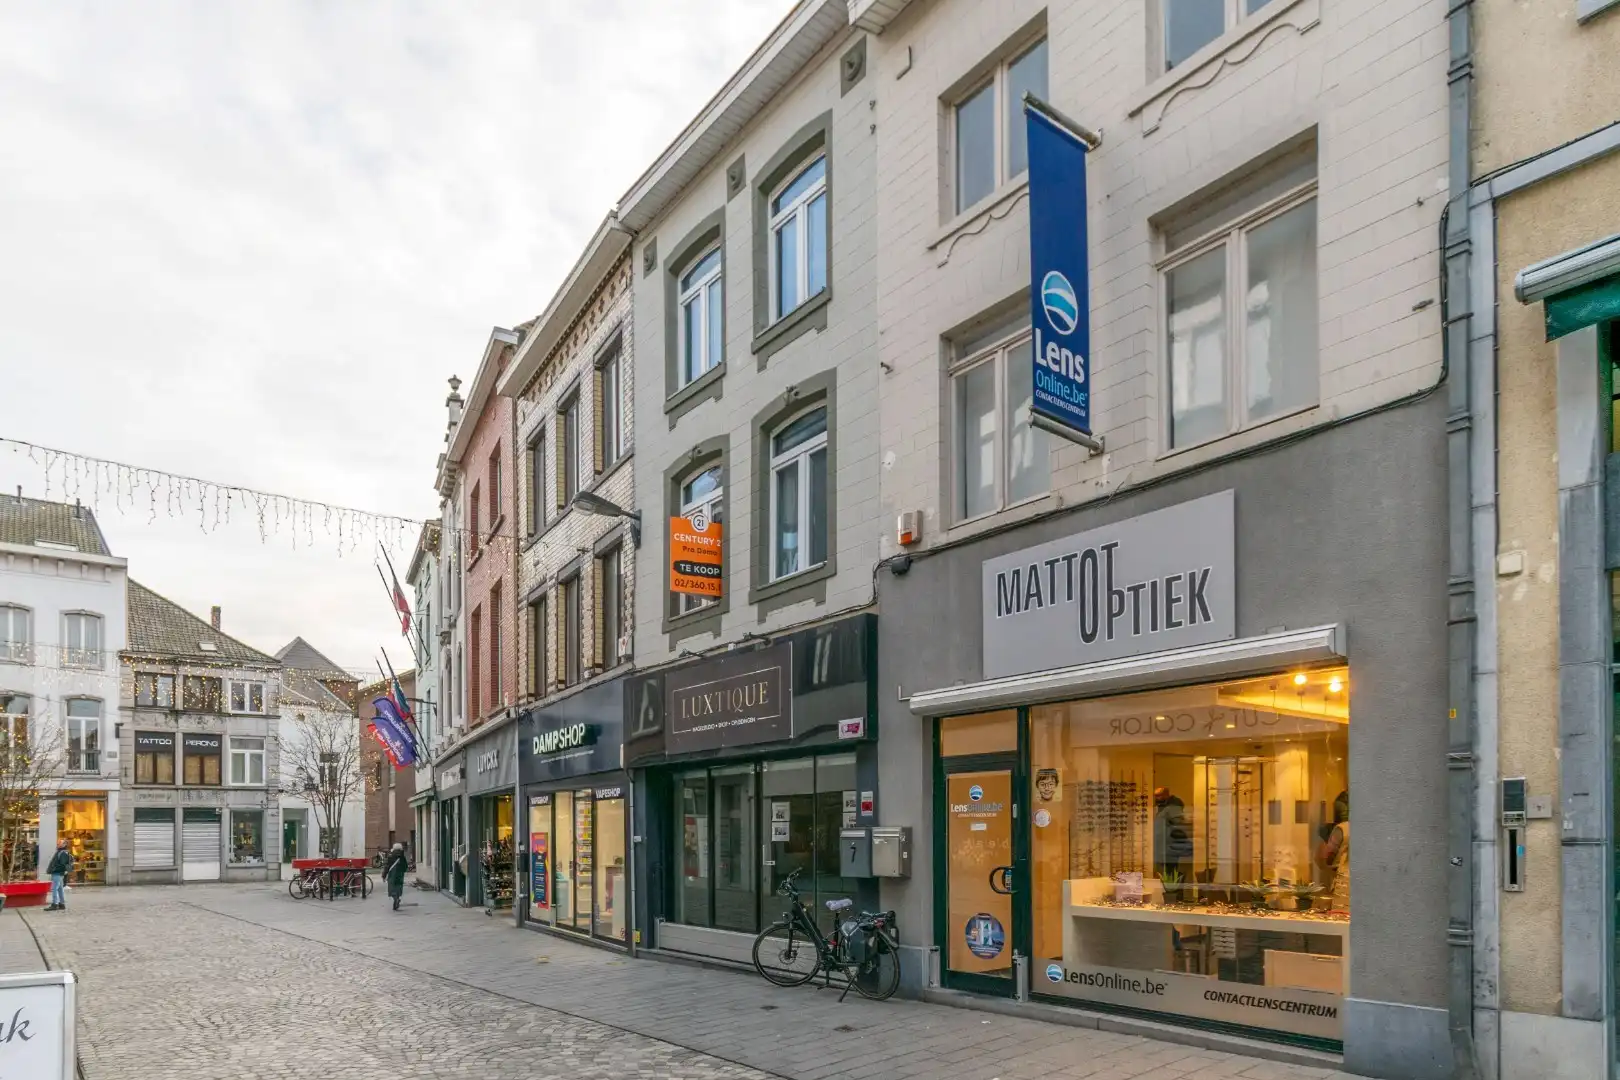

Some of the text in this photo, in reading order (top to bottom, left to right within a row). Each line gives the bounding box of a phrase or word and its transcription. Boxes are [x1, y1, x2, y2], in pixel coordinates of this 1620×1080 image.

[1035, 327, 1085, 384] Lens
[1036, 369, 1086, 407] Online.be
[1035, 389, 1086, 417] CONTACTLENSCENTRUM
[696, 519, 704, 527] 21
[673, 532, 721, 547] CENTURY 2
[680, 563, 720, 575] TE KOOP
[674, 578, 721, 592] 02/360.15.
[682, 681, 769, 719] LUXTIQUE
[138, 737, 172, 745] TATTOO
[533, 722, 585, 755] DAMPSHOP
[595, 787, 621, 799] VAPESHOP
[850, 846, 857, 863] 7
[1063, 967, 1166, 996] LensOnline.be
[1203, 989, 1338, 1019] CONTACTLENSCENTRUM
